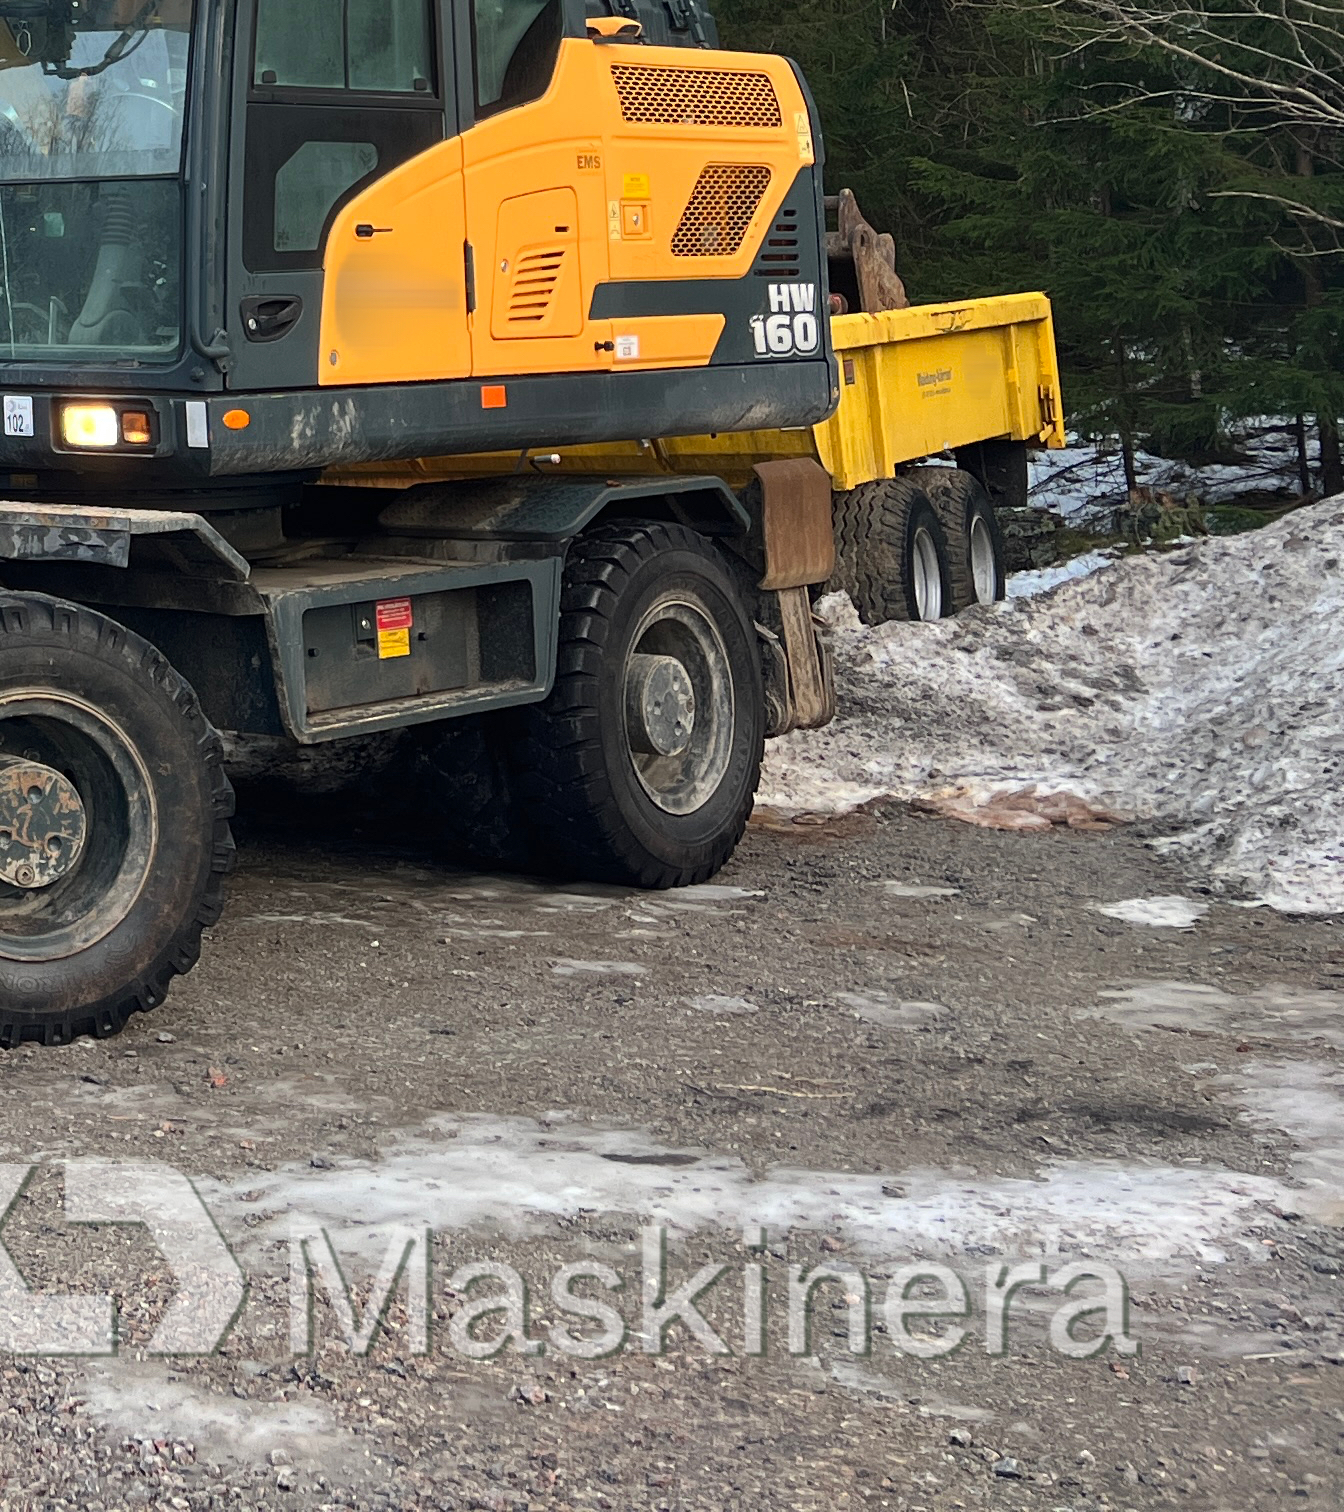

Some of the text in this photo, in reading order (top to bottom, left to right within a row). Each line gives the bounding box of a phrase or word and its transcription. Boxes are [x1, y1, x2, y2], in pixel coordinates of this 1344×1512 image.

[576, 155, 601, 169] EMS
[768, 283, 815, 313] HW
[749, 313, 819, 355] 160
[7, 413, 24, 433] 102
